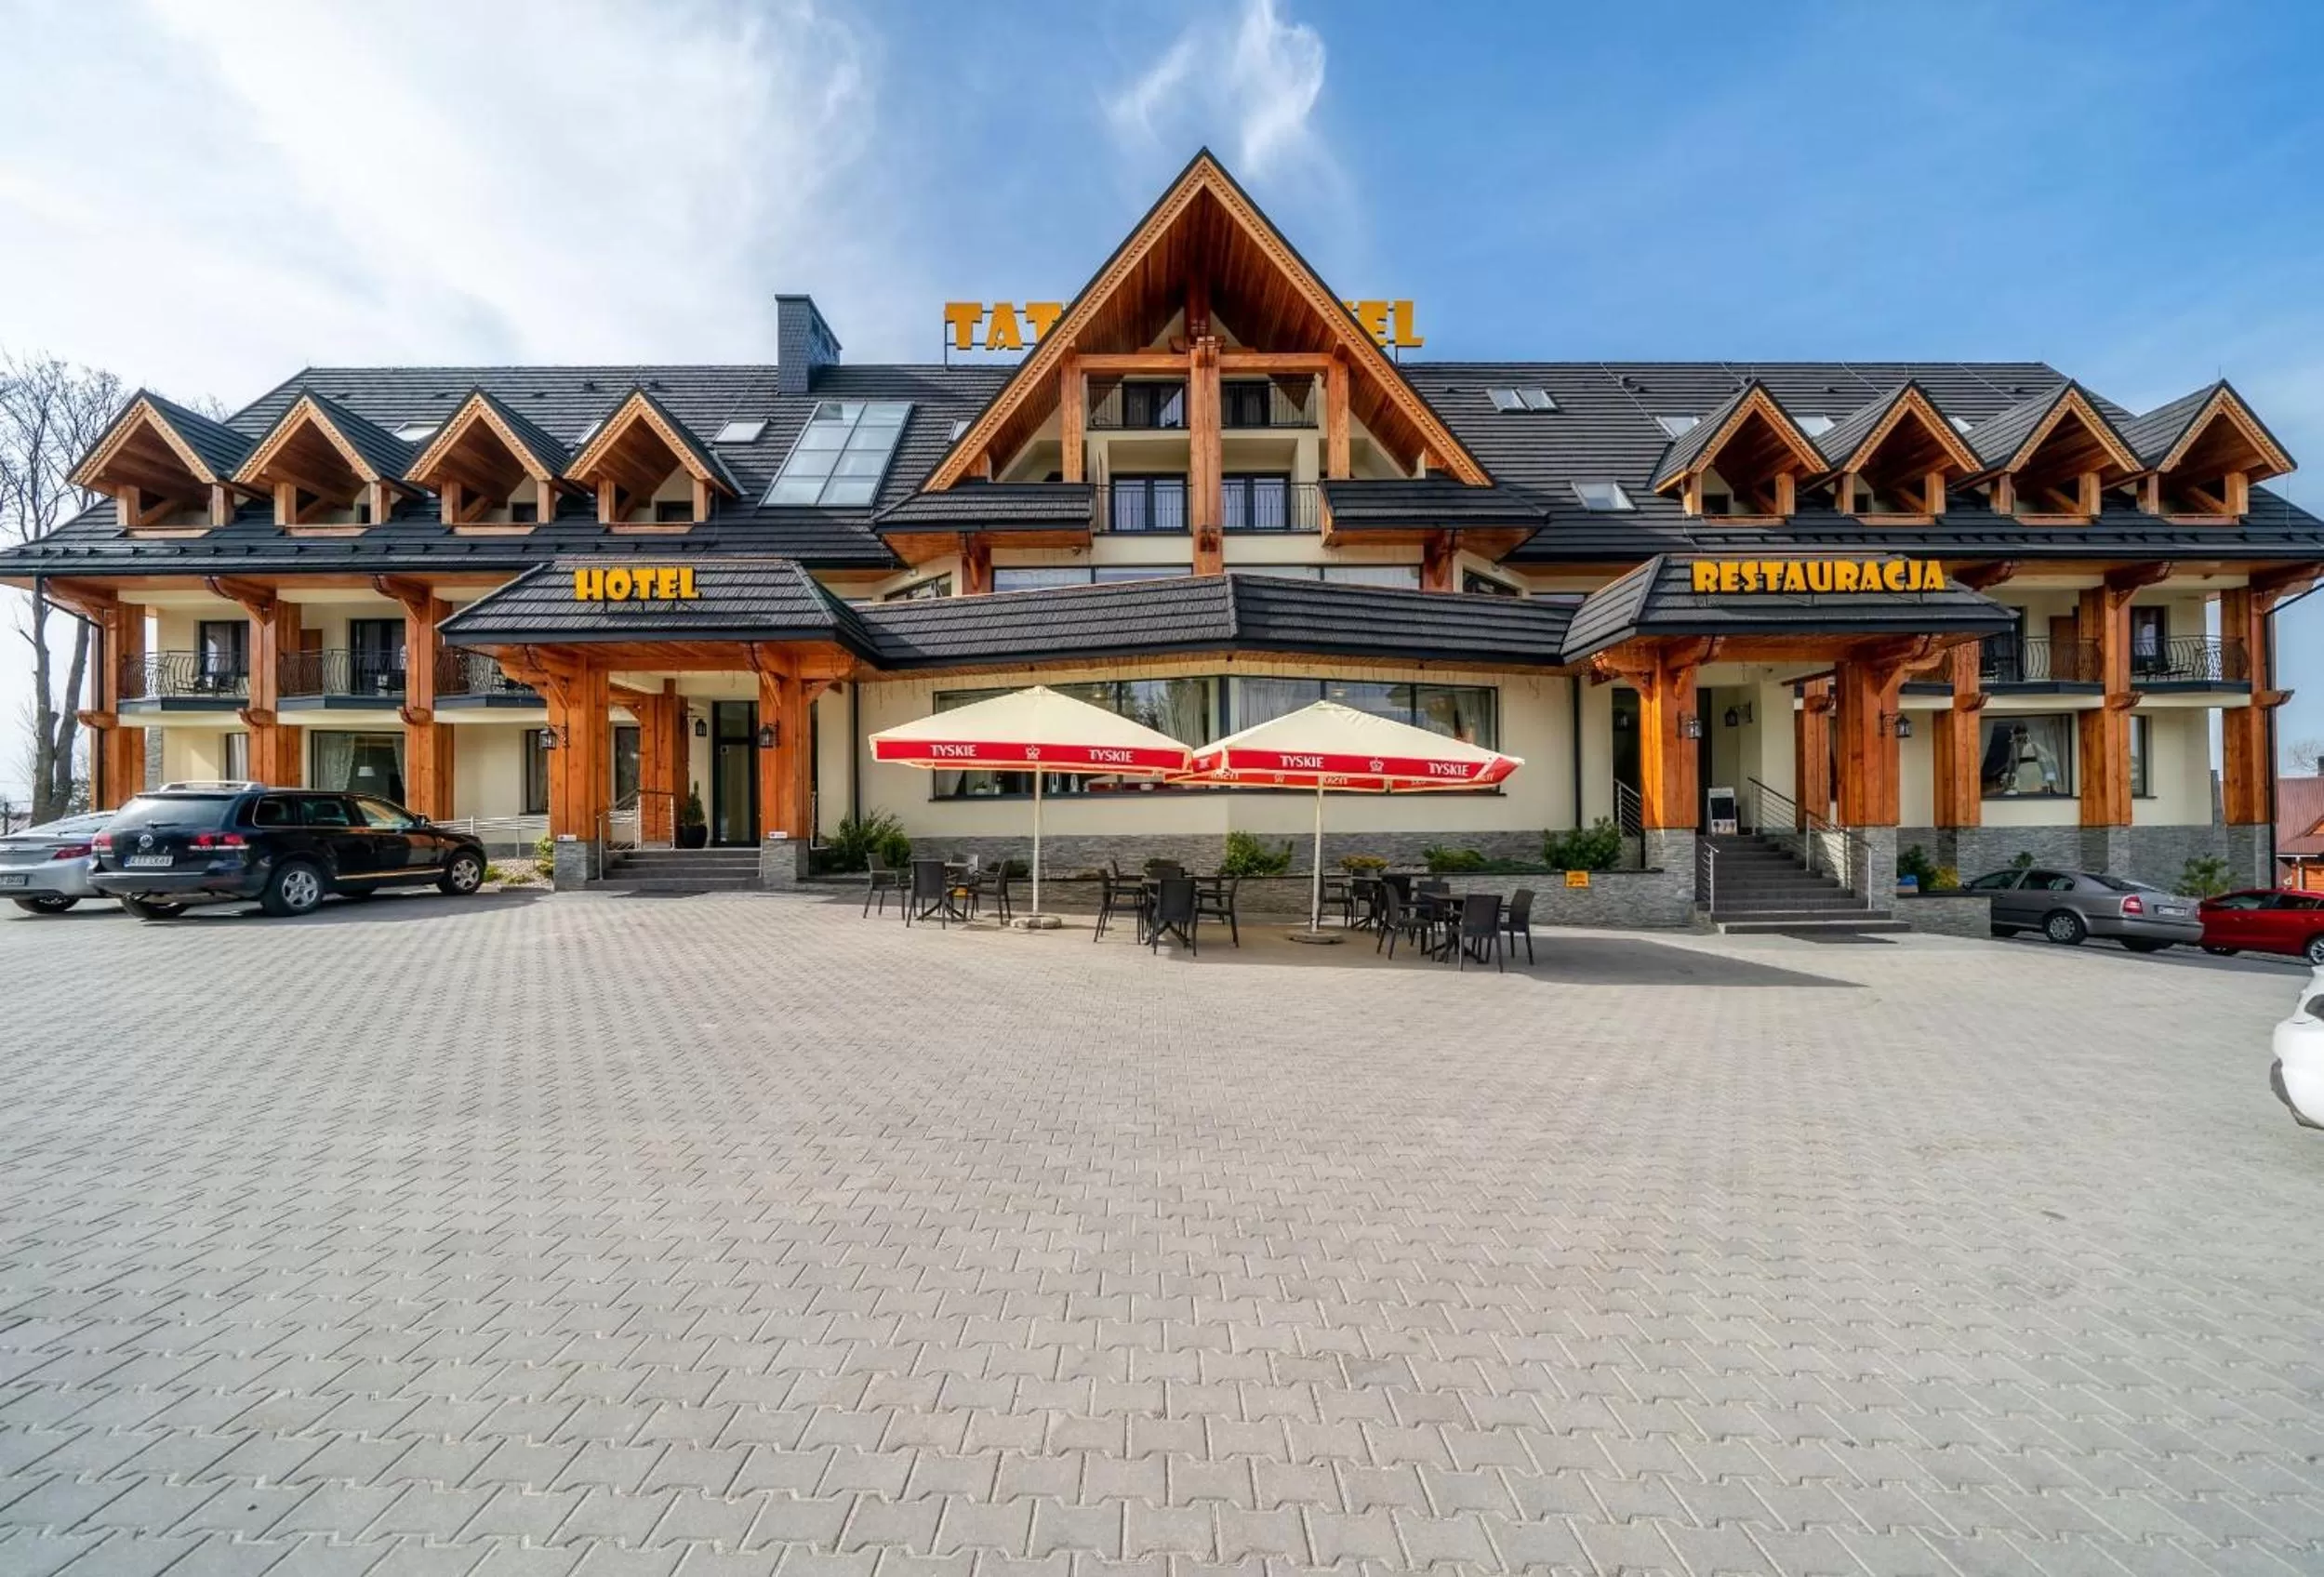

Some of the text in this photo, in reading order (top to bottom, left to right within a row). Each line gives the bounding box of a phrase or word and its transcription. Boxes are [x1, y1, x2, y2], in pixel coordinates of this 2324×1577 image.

[945, 302, 1069, 350] TAT
[575, 567, 700, 602] HOTEL
[1691, 560, 1946, 592] RESTAURACJA
[930, 744, 1134, 762] TYSKIE TYSKIE
[1280, 755, 1324, 768] TYSKIE
[1428, 762, 1469, 776] TYSKIE
